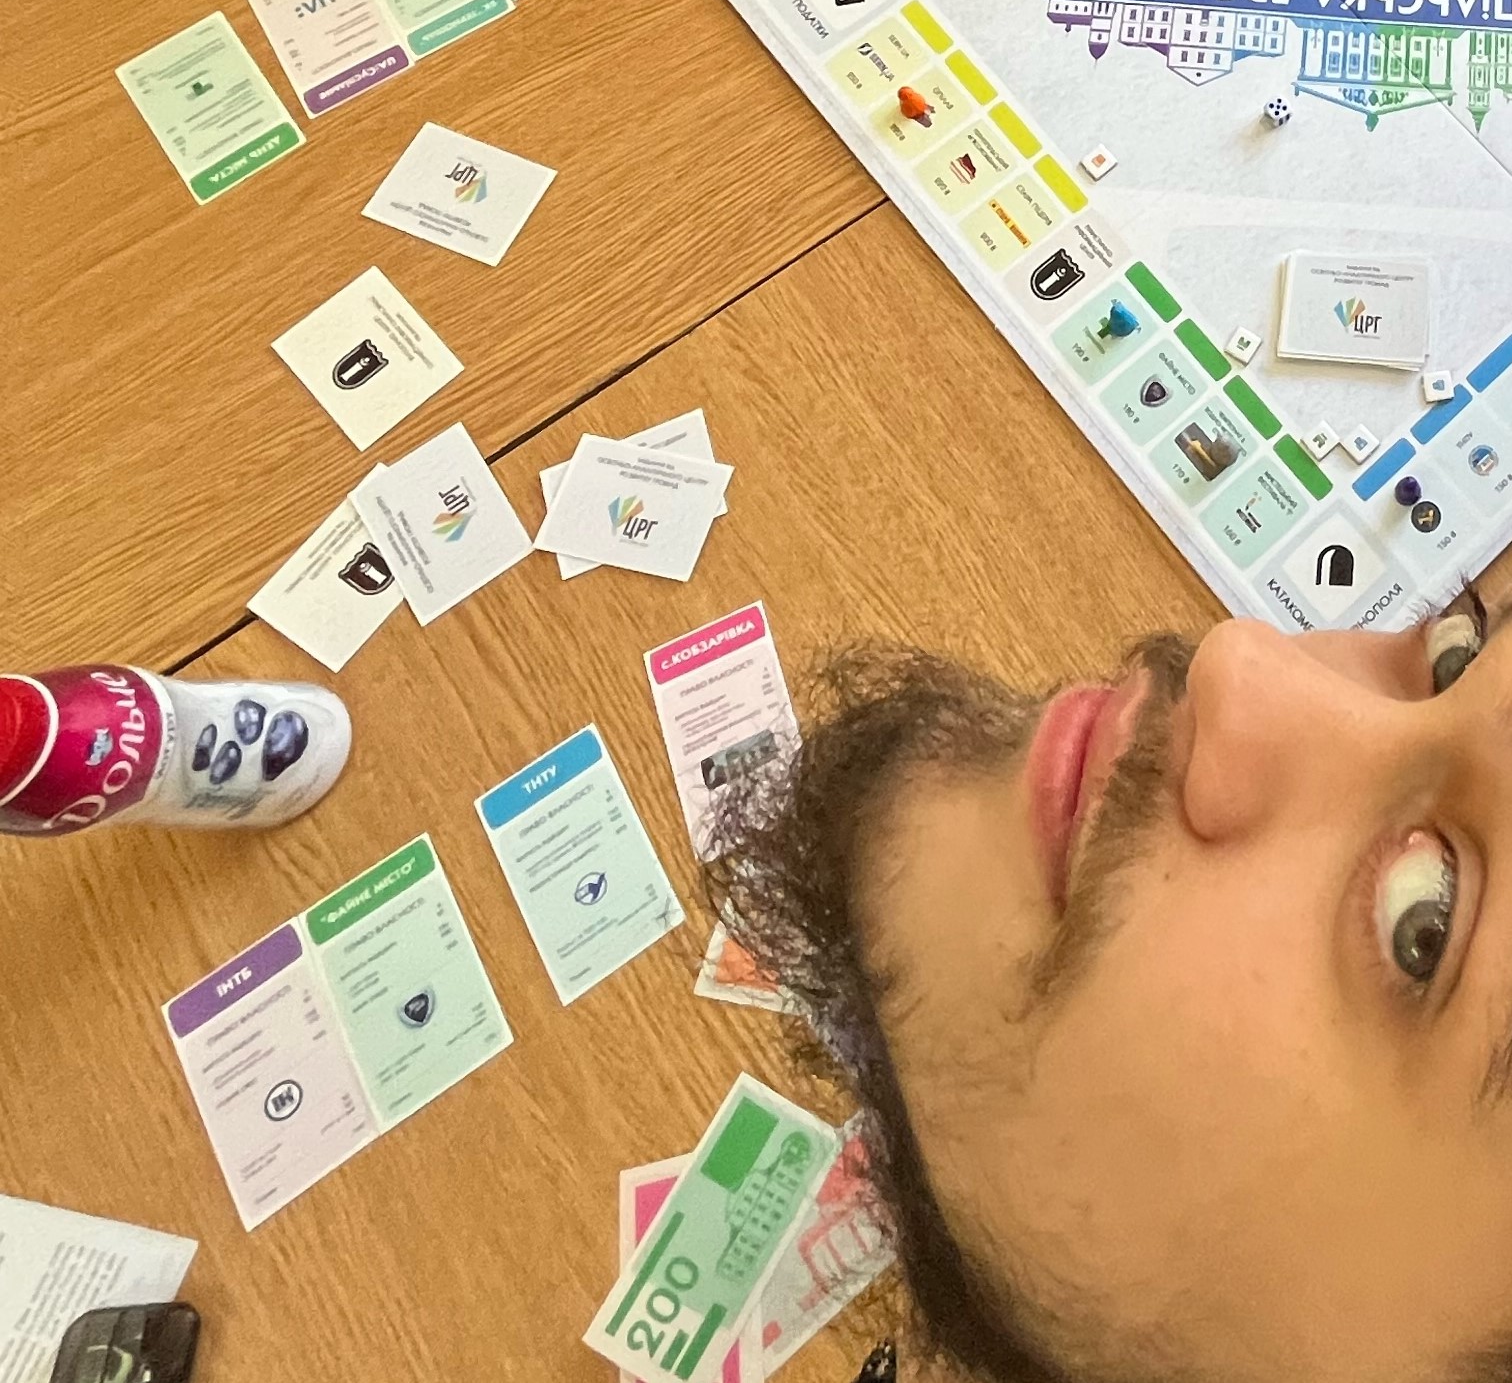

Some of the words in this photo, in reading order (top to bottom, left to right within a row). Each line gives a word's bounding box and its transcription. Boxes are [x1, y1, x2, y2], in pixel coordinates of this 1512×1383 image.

[443, 160, 478, 186] ЦРГ
[1353, 313, 1383, 335] ЦРГ
[437, 479, 473, 516] ЦРГ
[621, 514, 659, 542] ЦРГ
[1266, 578, 1316, 632] КАТАКОМ
[1350, 582, 1403, 630] НОПОЛЯ
[658, 617, 756, 671] с.КОБЗАРІВКА
[520, 762, 561, 796] ТНТУ
[213, 963, 255, 998] ІНТБ
[626, 1255, 700, 1359] 200
